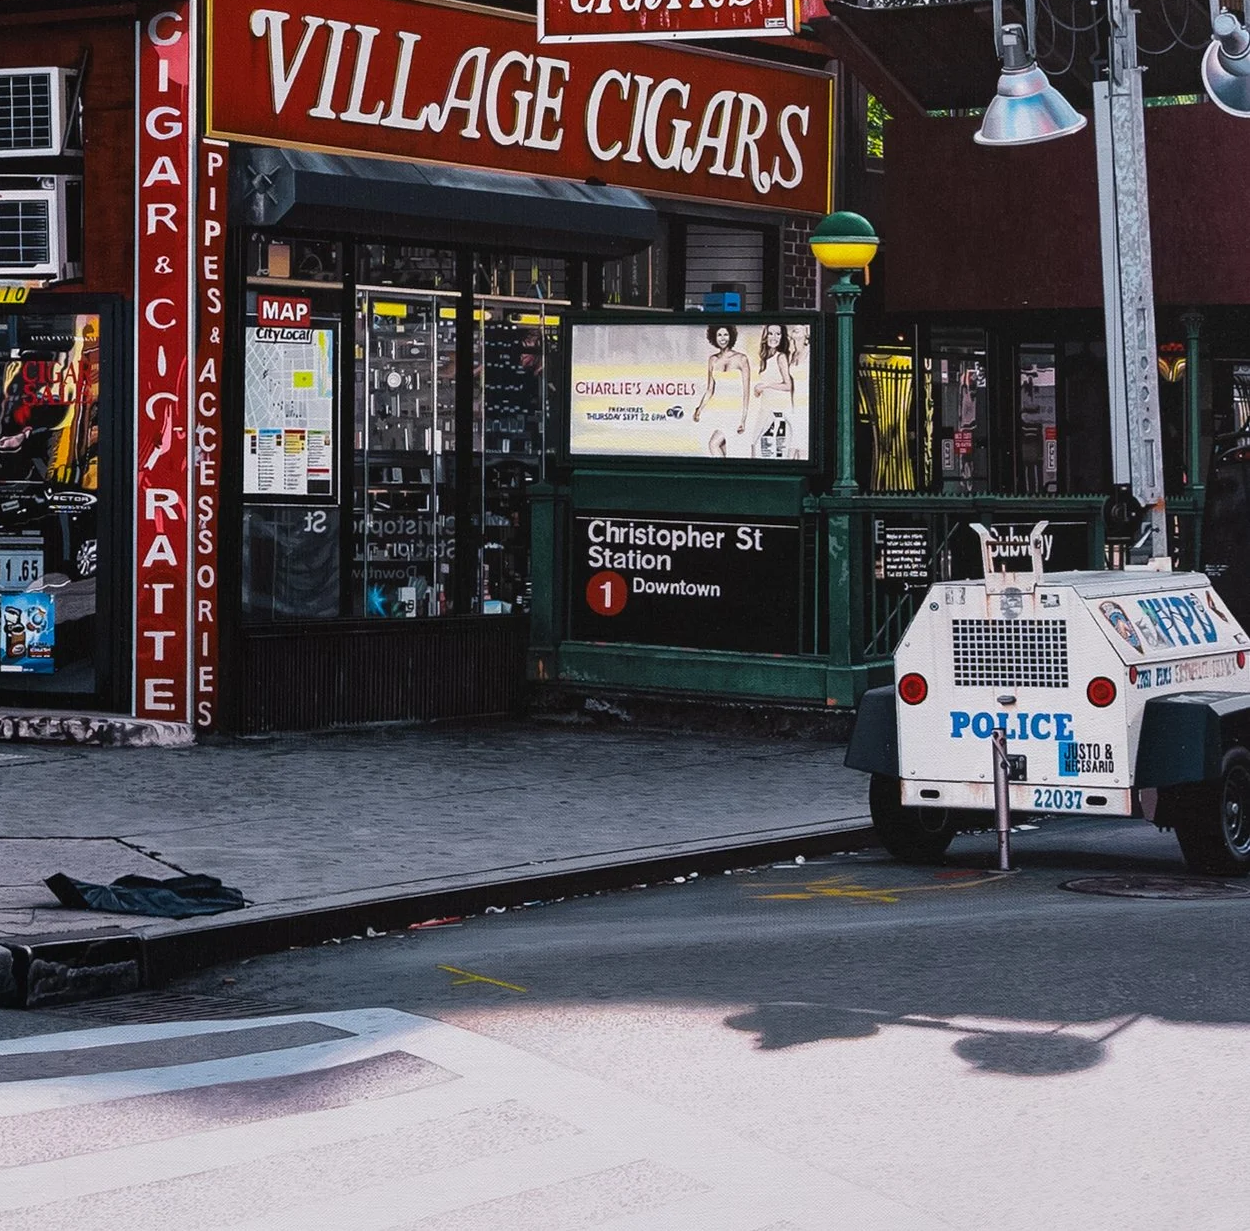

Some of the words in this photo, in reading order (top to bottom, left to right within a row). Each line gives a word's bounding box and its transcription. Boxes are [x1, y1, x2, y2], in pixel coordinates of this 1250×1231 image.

[250, 9, 571, 151] VILLAGE
[586, 69, 810, 194] CIGARS
[143, 11, 183, 235] CIGAR
[204, 152, 223, 314] PIPES
[154, 256, 174, 274] &
[262, 300, 308, 322] MAP
[210, 326, 221, 344] &
[575, 381, 641, 395] CHARLIE'S
[646, 383, 696, 396] ANGELS
[198, 358, 219, 727] ACCESSORIES
[588, 520, 725, 551] Christopher
[736, 527, 763, 551] St
[989, 526, 1053, 561] Subwy
[588, 546, 672, 571] Station
[600, 581, 612, 608] 1
[632, 577, 721, 598] Downtown
[950, 711, 1074, 741] POLICE
[1064, 742, 1100, 760] JUSTO
[1105, 743, 1113, 760] &
[1065, 760, 1114, 773] NECESARIO
[1034, 788, 1083, 810] 22037
